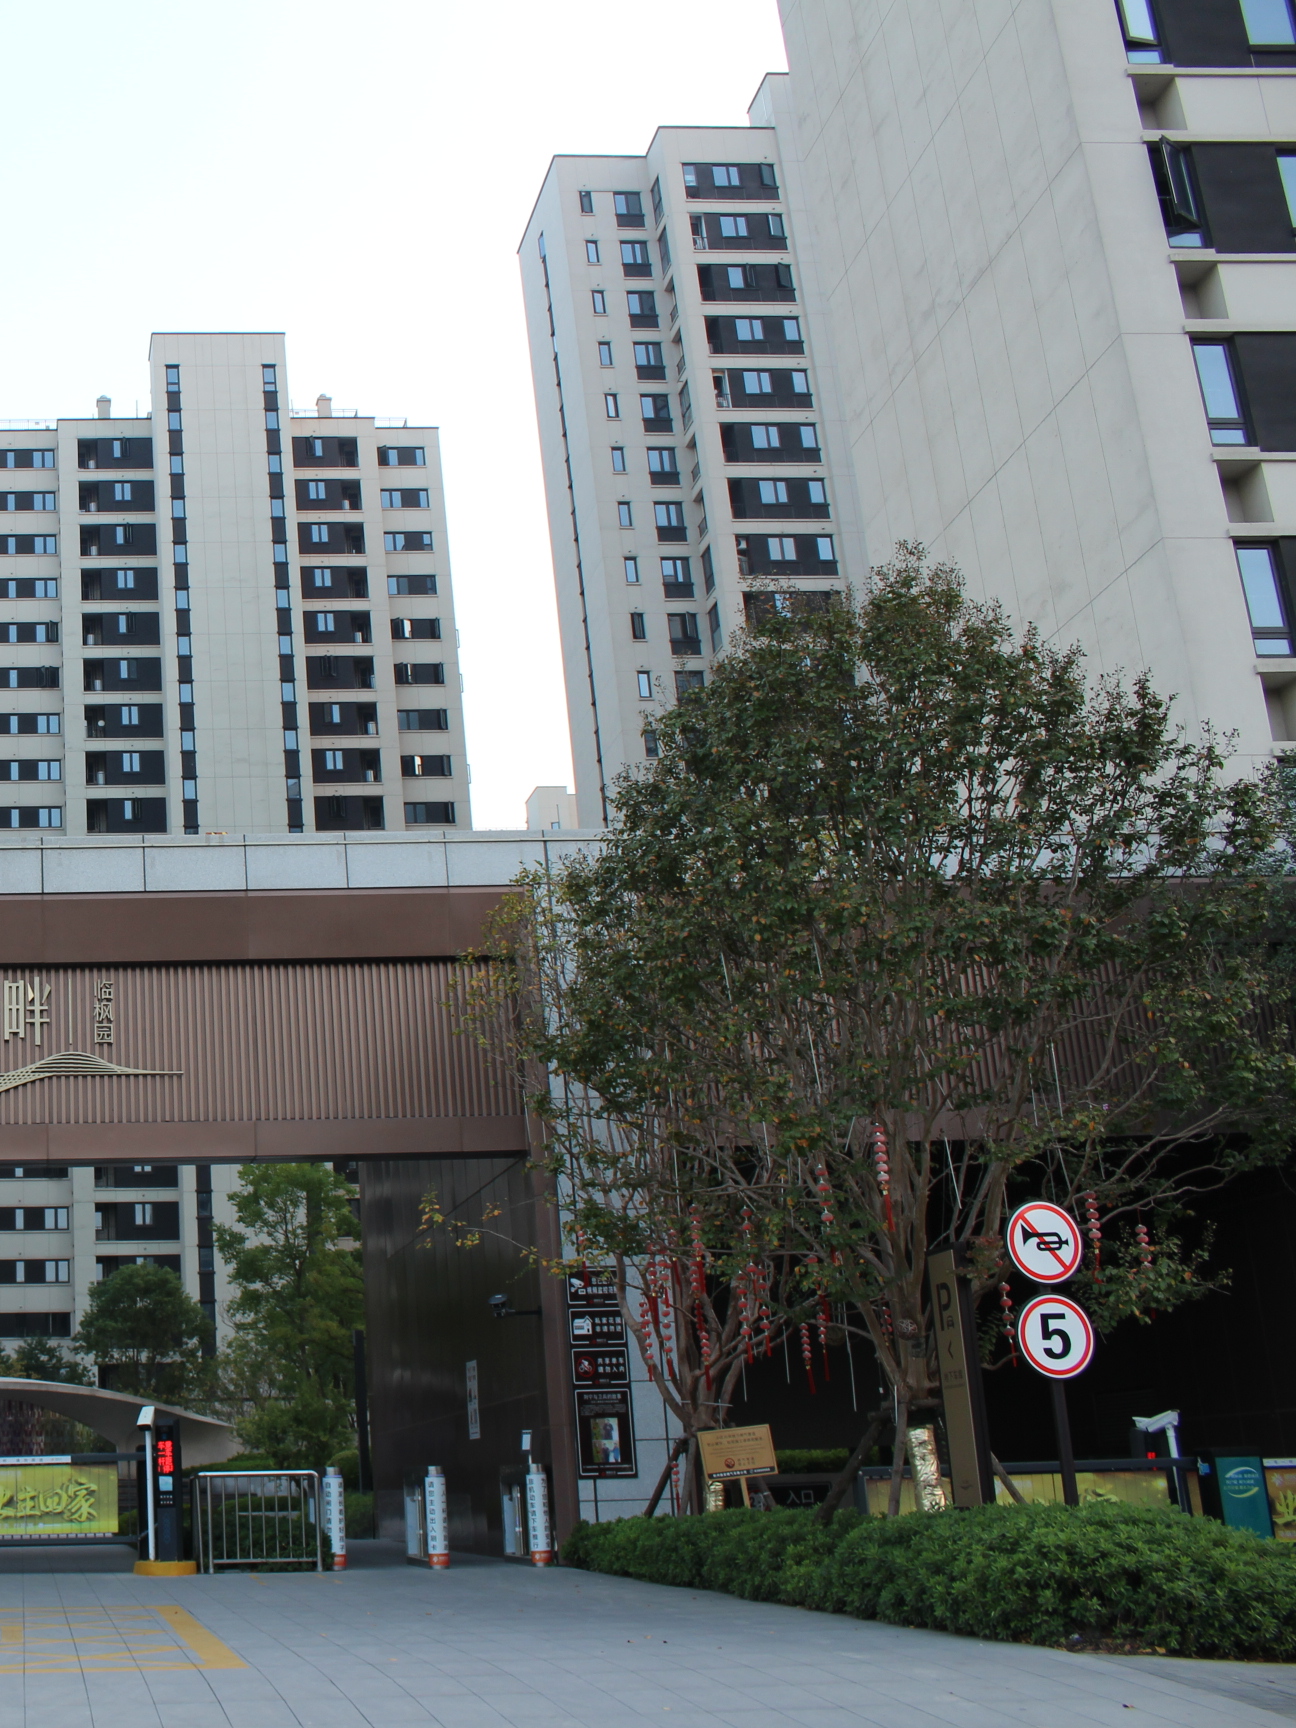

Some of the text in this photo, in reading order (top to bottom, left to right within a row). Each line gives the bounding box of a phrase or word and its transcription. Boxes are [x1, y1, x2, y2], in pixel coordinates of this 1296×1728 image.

[93, 979, 114, 1044] 临枫园
[936, 1282, 952, 1332] P
[1040, 1313, 1072, 1360] 5
[597, 1357, 624, 1365] 共享单车
[597, 1365, 625, 1373] 请勿入内
[428, 1481, 438, 1551] 请您主动出入刷卡
[528, 1478, 540, 1549] 非机动车请下车推行
[787, 1490, 815, 1504] 入口
